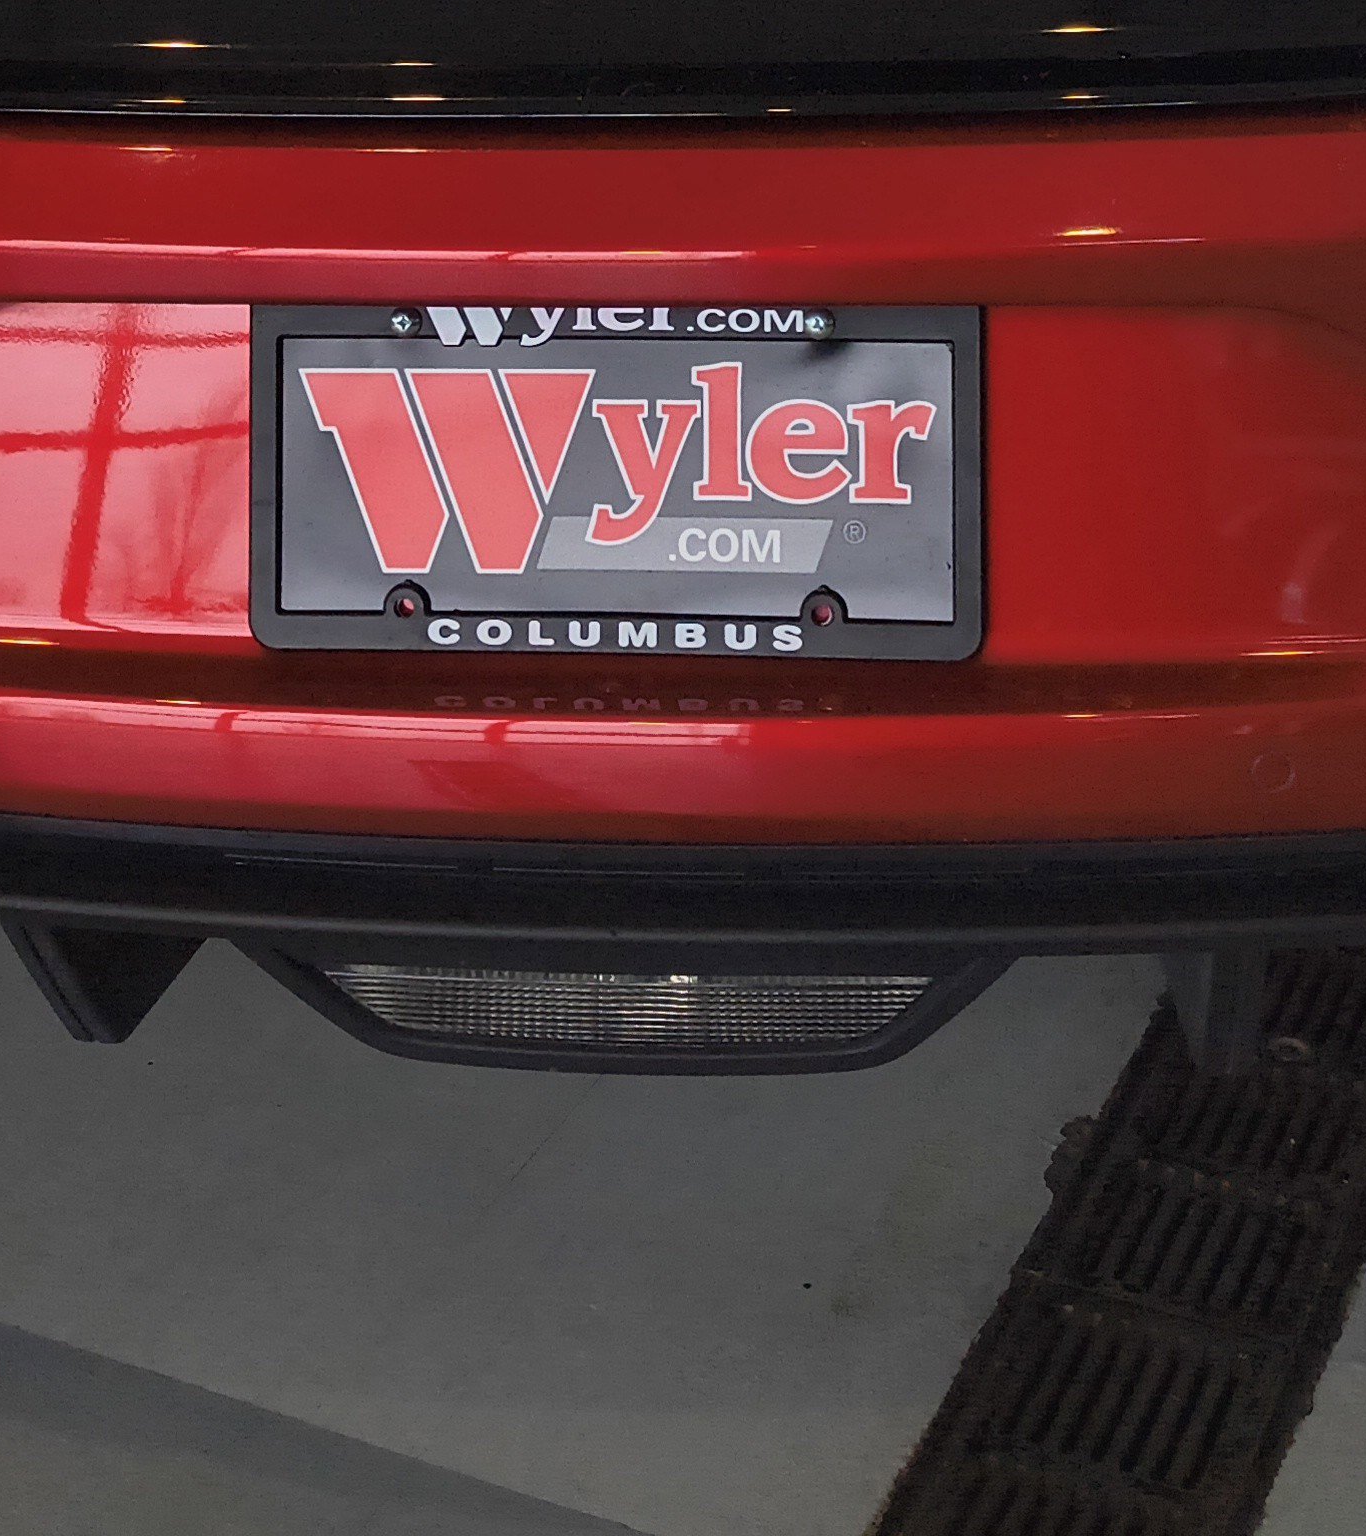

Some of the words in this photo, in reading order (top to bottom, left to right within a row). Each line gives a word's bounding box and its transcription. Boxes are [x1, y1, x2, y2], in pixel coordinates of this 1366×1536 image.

[299, 362, 938, 575] Wyler
[667, 526, 782, 564] .COM
[427, 618, 804, 652] COLUMBUS
